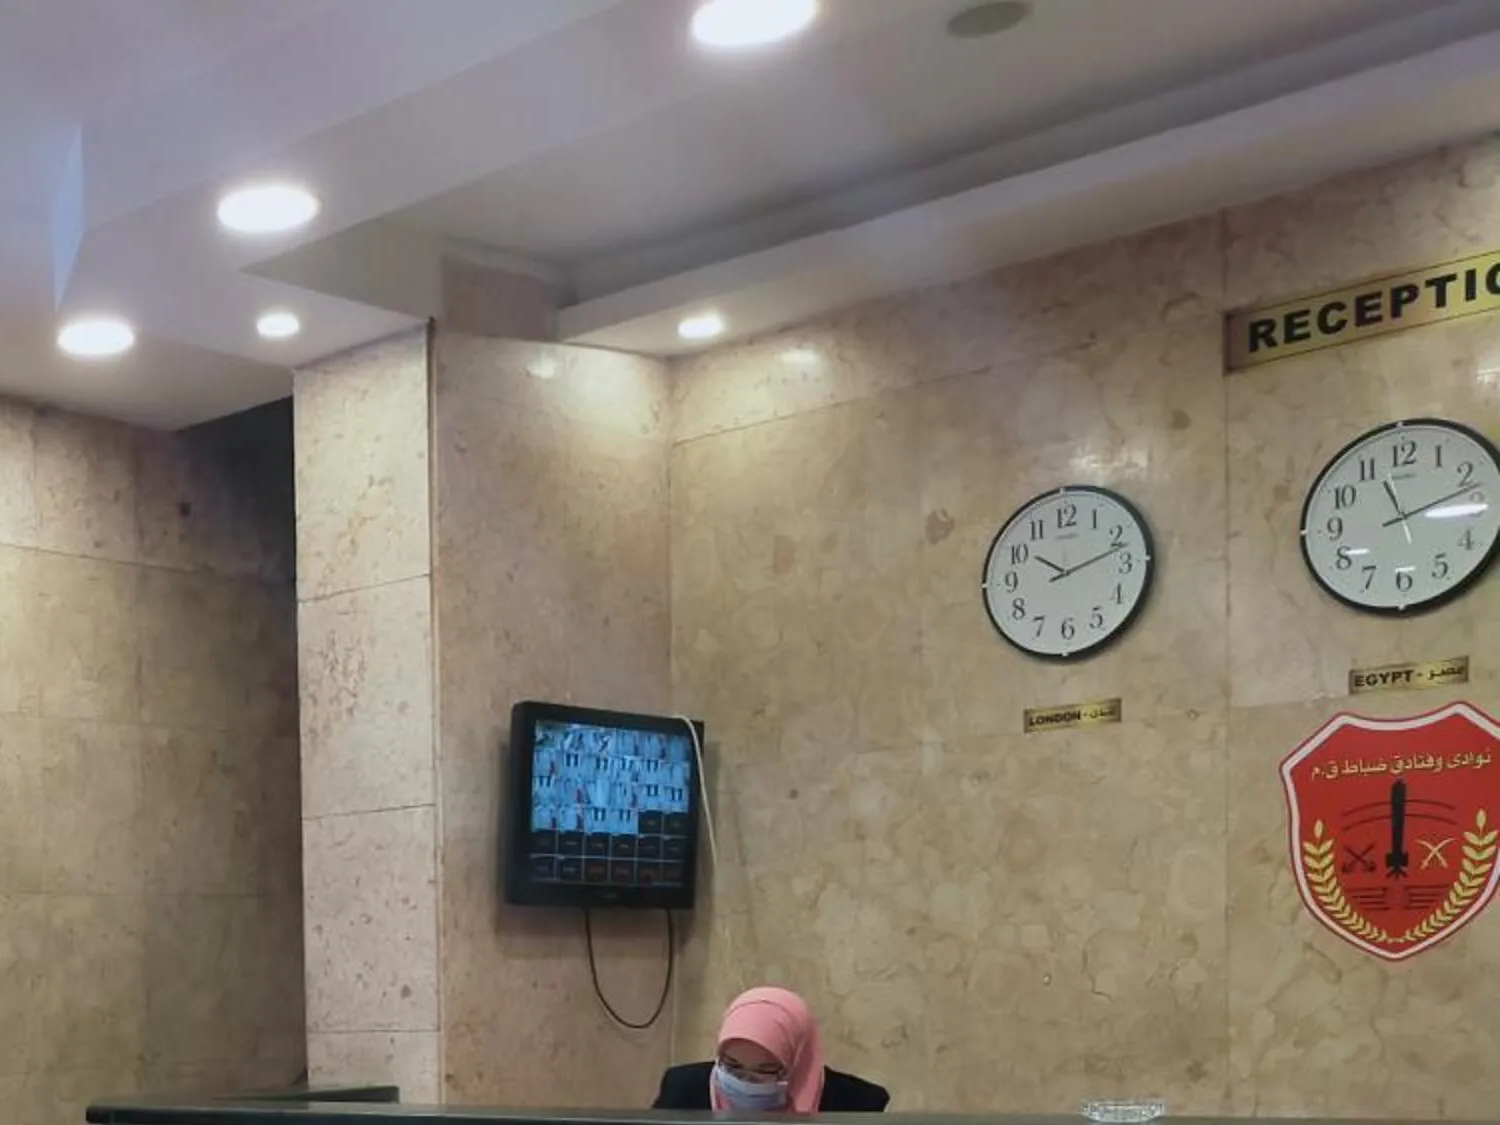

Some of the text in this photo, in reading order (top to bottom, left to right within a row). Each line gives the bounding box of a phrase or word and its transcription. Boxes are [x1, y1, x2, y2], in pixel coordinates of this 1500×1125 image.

[1392, 440, 1417, 468] 12
[1434, 444, 1443, 468] 1
[1359, 457, 1376, 481] 11
[1457, 461, 1475, 487] 2
[1334, 484, 1357, 510] 10
[1056, 504, 1077, 528] 12
[1091, 508, 1098, 529] 1
[1030, 519, 1044, 541] 11
[1109, 525, 1125, 548] 2
[1327, 517, 1343, 541] 9
[1458, 529, 1475, 551] 4
[1011, 543, 1029, 565] 10
[1118, 552, 1133, 574] 3
[1336, 545, 1352, 570] 8
[1431, 552, 1449, 579] 5
[1005, 571, 1019, 593] 9
[1362, 565, 1377, 590] 7
[1395, 567, 1413, 592] 6
[1012, 597, 1026, 621] 8
[1089, 606, 1104, 629] 5
[1033, 615, 1045, 637] 7
[1061, 617, 1075, 640] 6
[1355, 669, 1414, 687] EGYPT
[1029, 710, 1080, 726] LONDON
